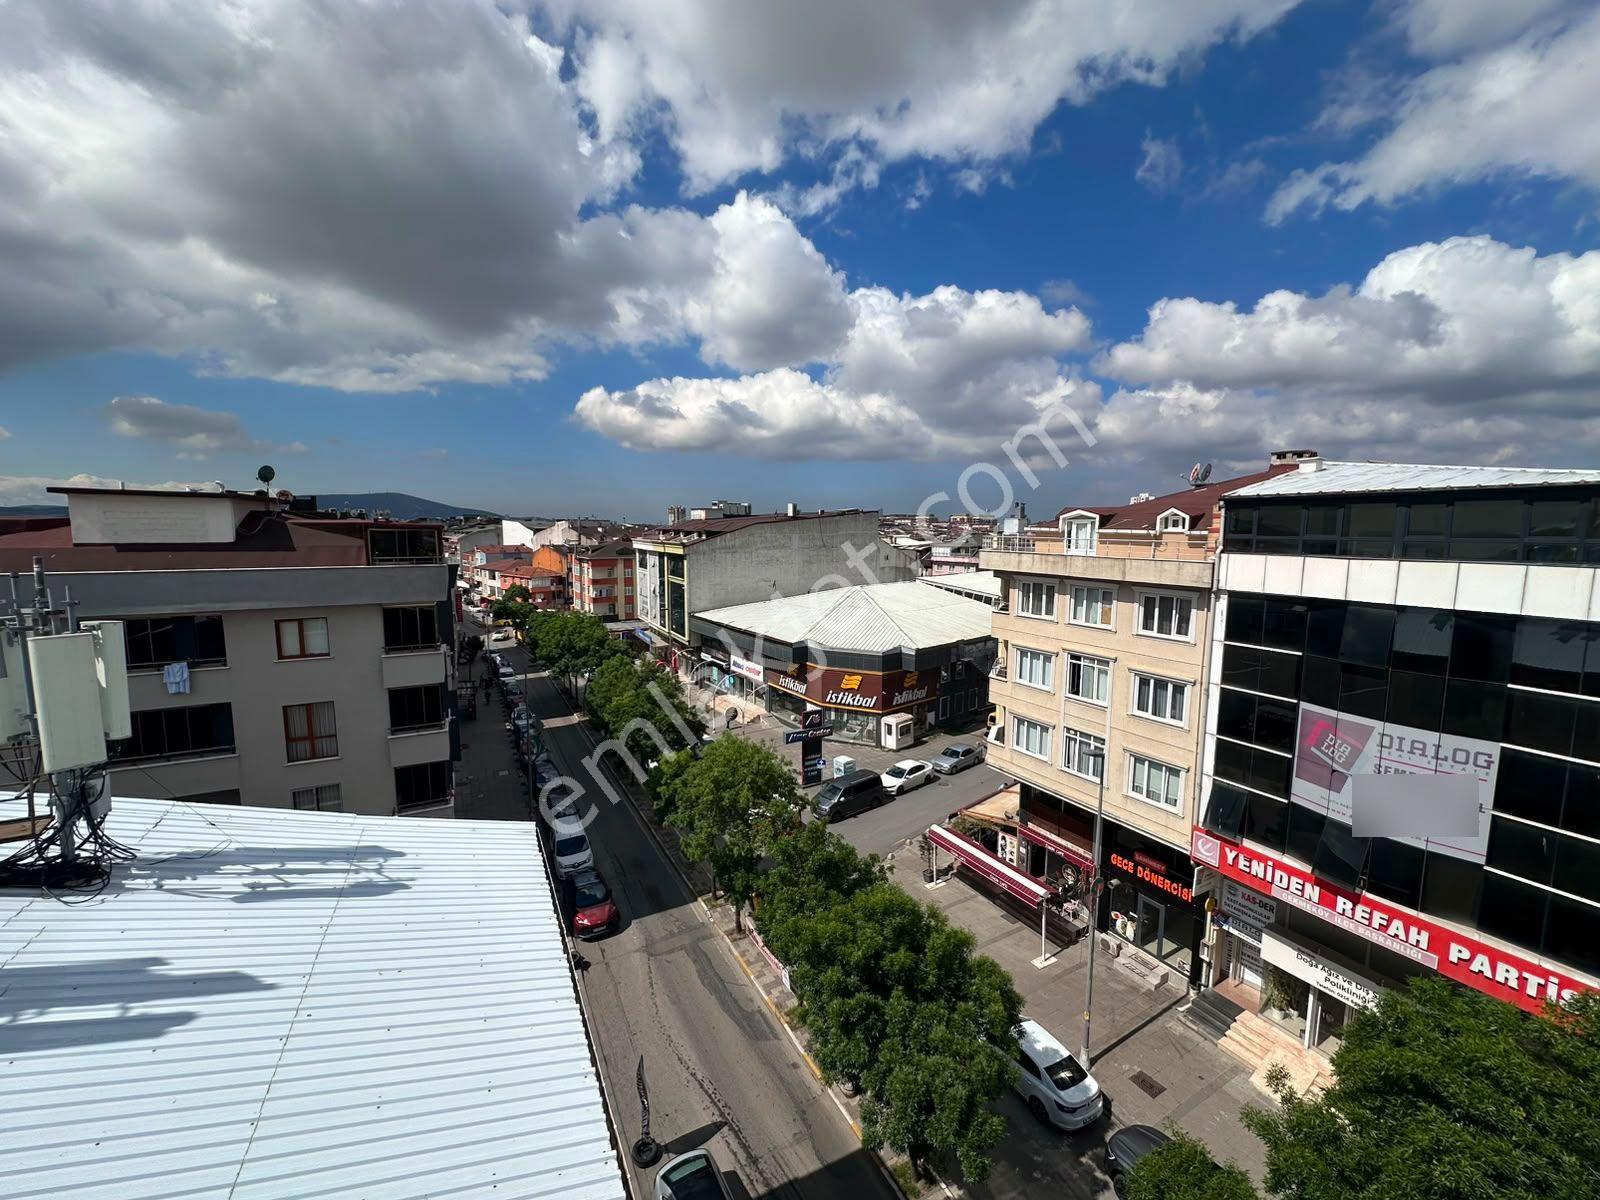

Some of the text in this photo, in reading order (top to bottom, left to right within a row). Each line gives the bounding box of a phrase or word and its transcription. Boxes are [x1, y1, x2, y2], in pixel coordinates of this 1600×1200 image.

[825, 690, 877, 708] istikbal
[892, 686, 928, 705] istikbal
[1321, 742, 1346, 762] LOG
[1326, 733, 1351, 755] DIA
[1376, 732, 1495, 770] DIALOG
[1110, 853, 1134, 874] GECE
[1137, 866, 1192, 902] DÖNERCİSİ
[1241, 891, 1275, 914] KAS-DER
[1223, 847, 1321, 904] YENİDEN
[1336, 895, 1430, 951] REFAH
[1449, 942, 1581, 1014] PARTİS
[1342, 976, 1353, 986] ve
